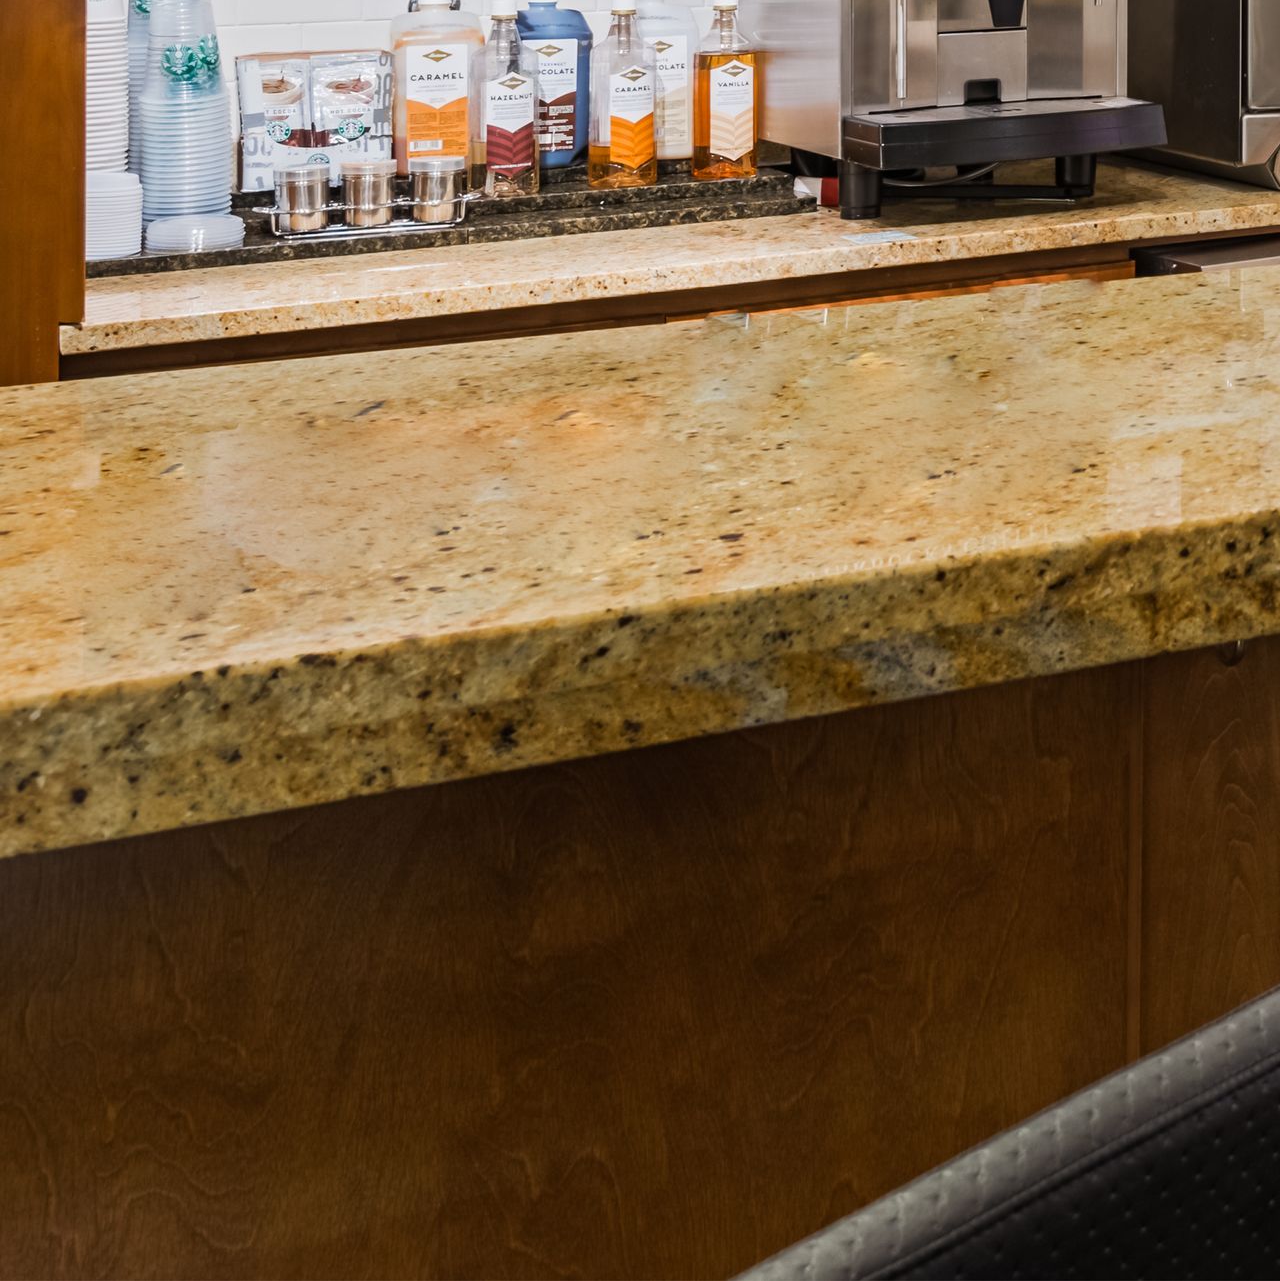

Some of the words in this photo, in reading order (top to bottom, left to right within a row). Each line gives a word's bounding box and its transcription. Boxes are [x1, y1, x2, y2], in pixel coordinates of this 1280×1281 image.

[410, 72, 464, 81] CARAMEL
[615, 85, 651, 93] CARAMEL
[490, 93, 533, 102] HAZELNUT
